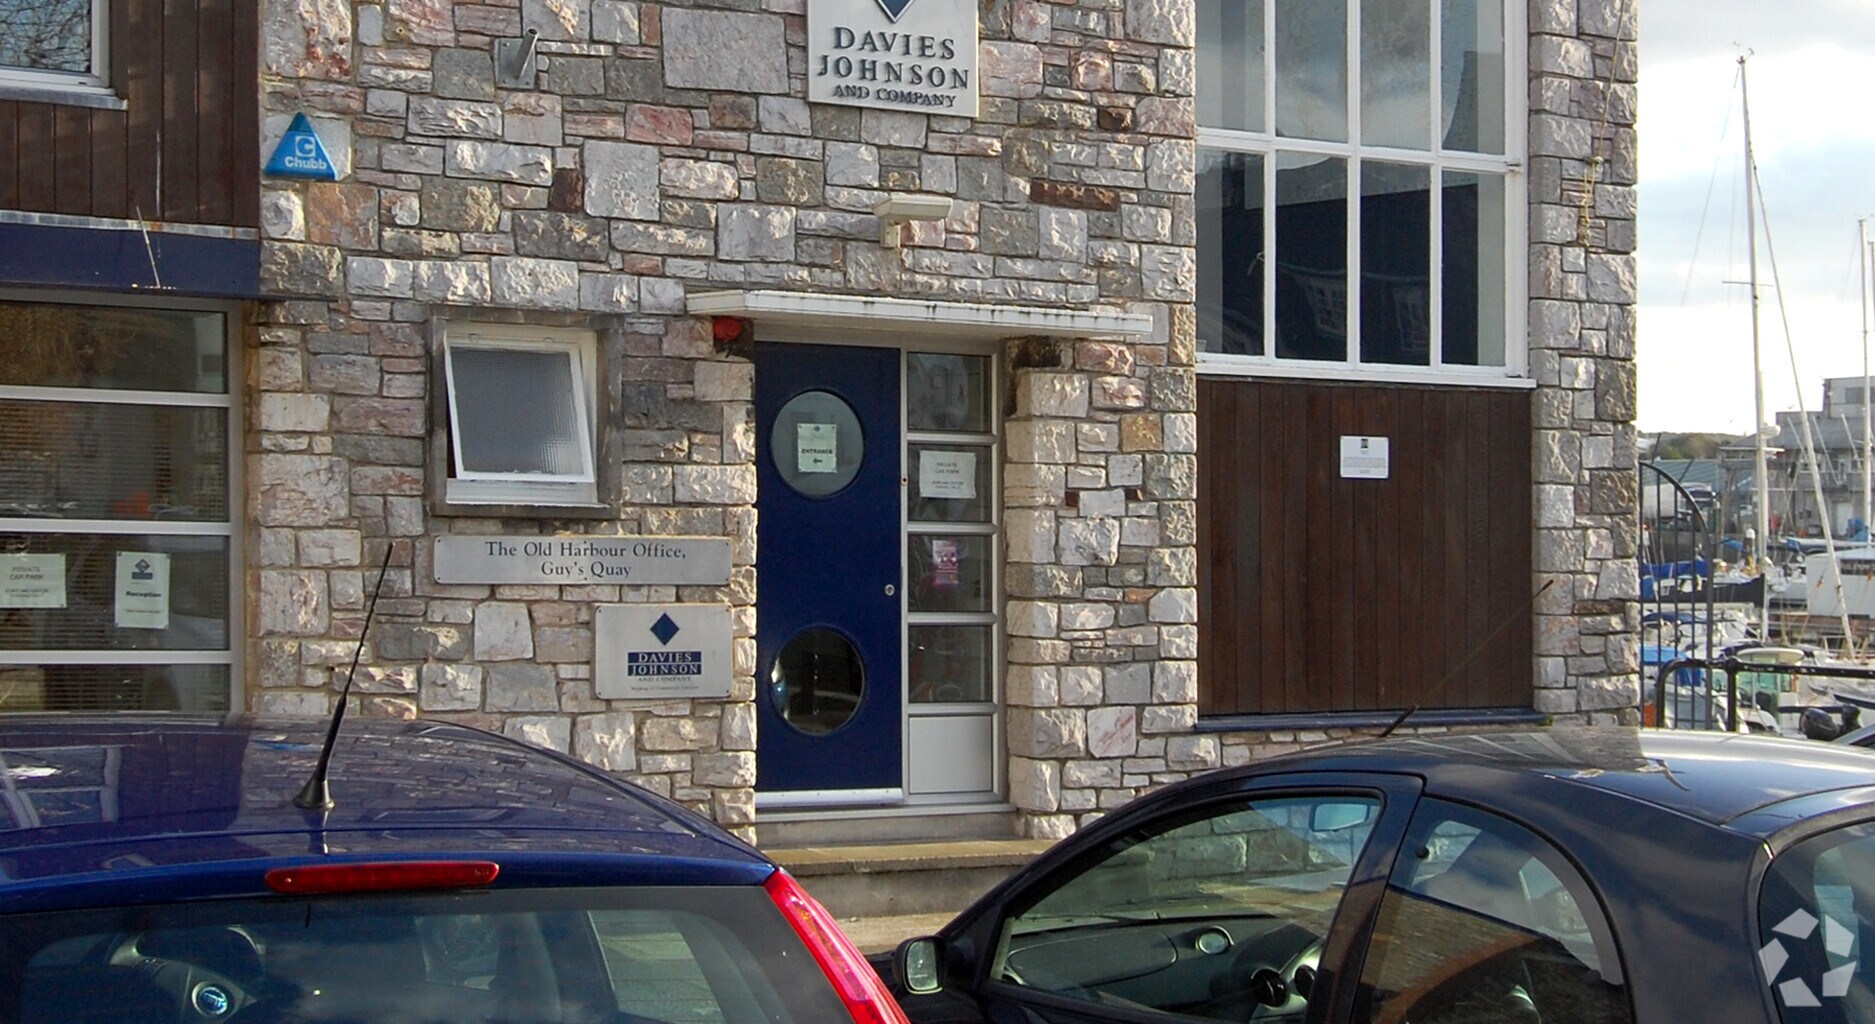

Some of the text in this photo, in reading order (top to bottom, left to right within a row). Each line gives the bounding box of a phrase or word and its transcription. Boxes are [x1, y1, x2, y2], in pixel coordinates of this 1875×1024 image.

[833, 27, 955, 60] DAVIES
[817, 54, 970, 90] JOHNSON
[832, 84, 957, 108] AND COMPANY
[284, 156, 327, 169] Chubb
[485, 541, 686, 559] The Old Harbour Office,
[541, 560, 632, 578] Guy's Quay
[125, 590, 162, 598] Reception
[638, 652, 692, 663] DAVIES
[630, 663, 699, 676] JOHNSON
